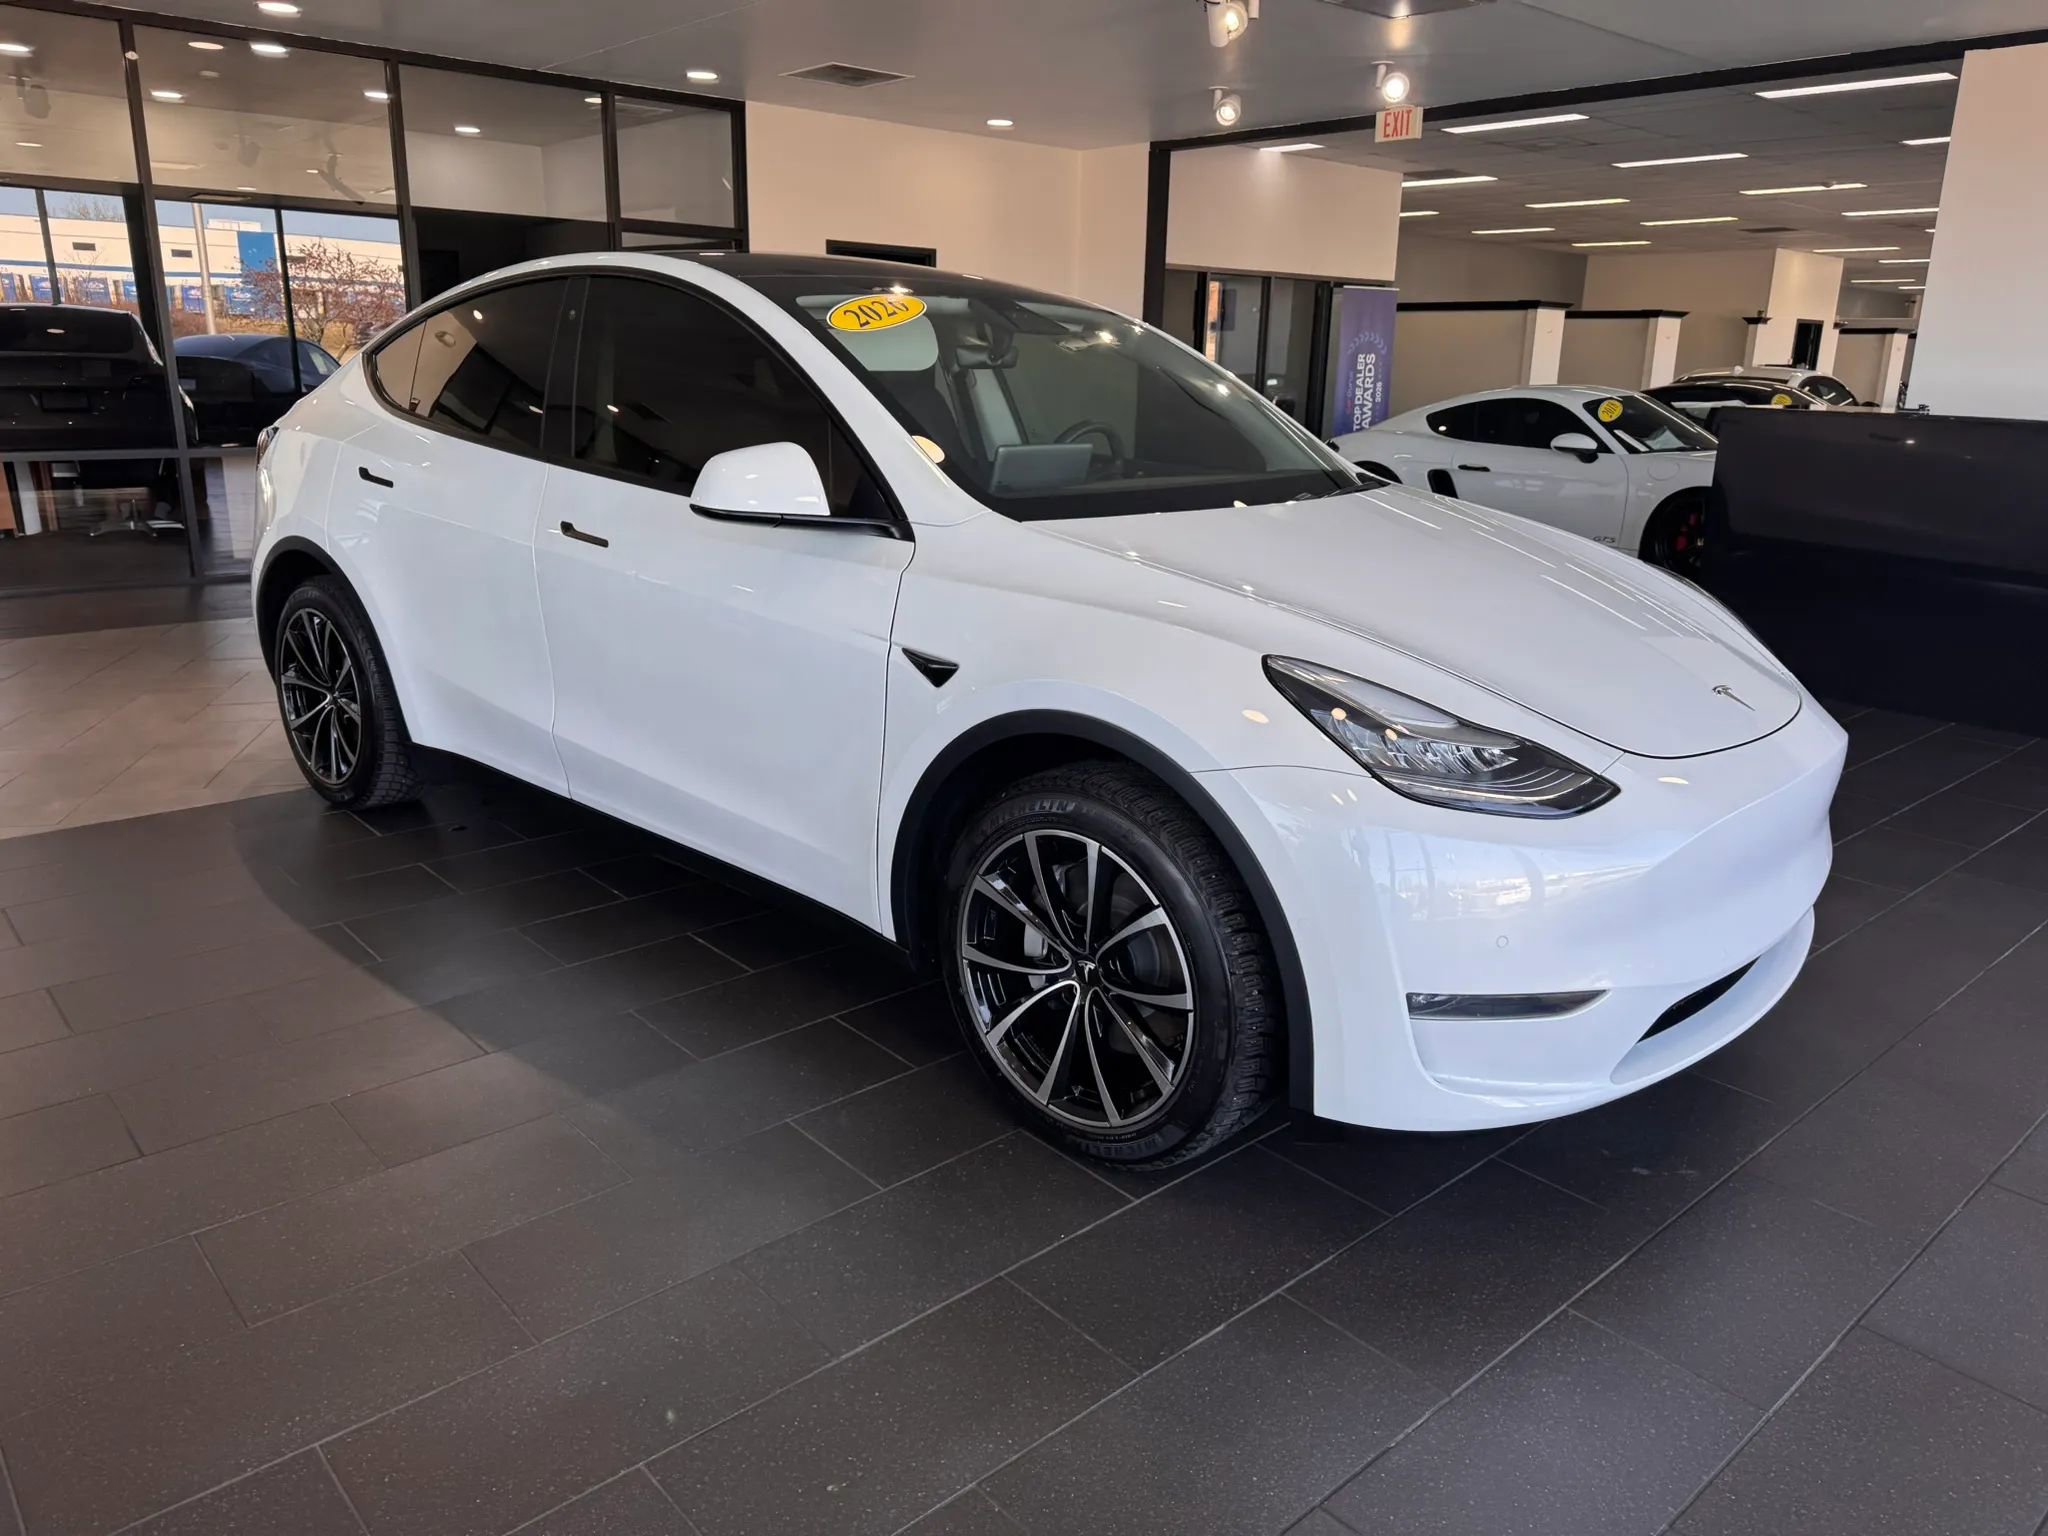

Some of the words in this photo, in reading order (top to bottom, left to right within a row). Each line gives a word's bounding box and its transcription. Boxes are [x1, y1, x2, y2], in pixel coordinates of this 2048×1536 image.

[1383, 109, 1413, 138] EXIT
[1354, 353, 1366, 405] DEALER
[1362, 353, 1376, 429] AWARDS
[1353, 406, 1362, 432] TOP
